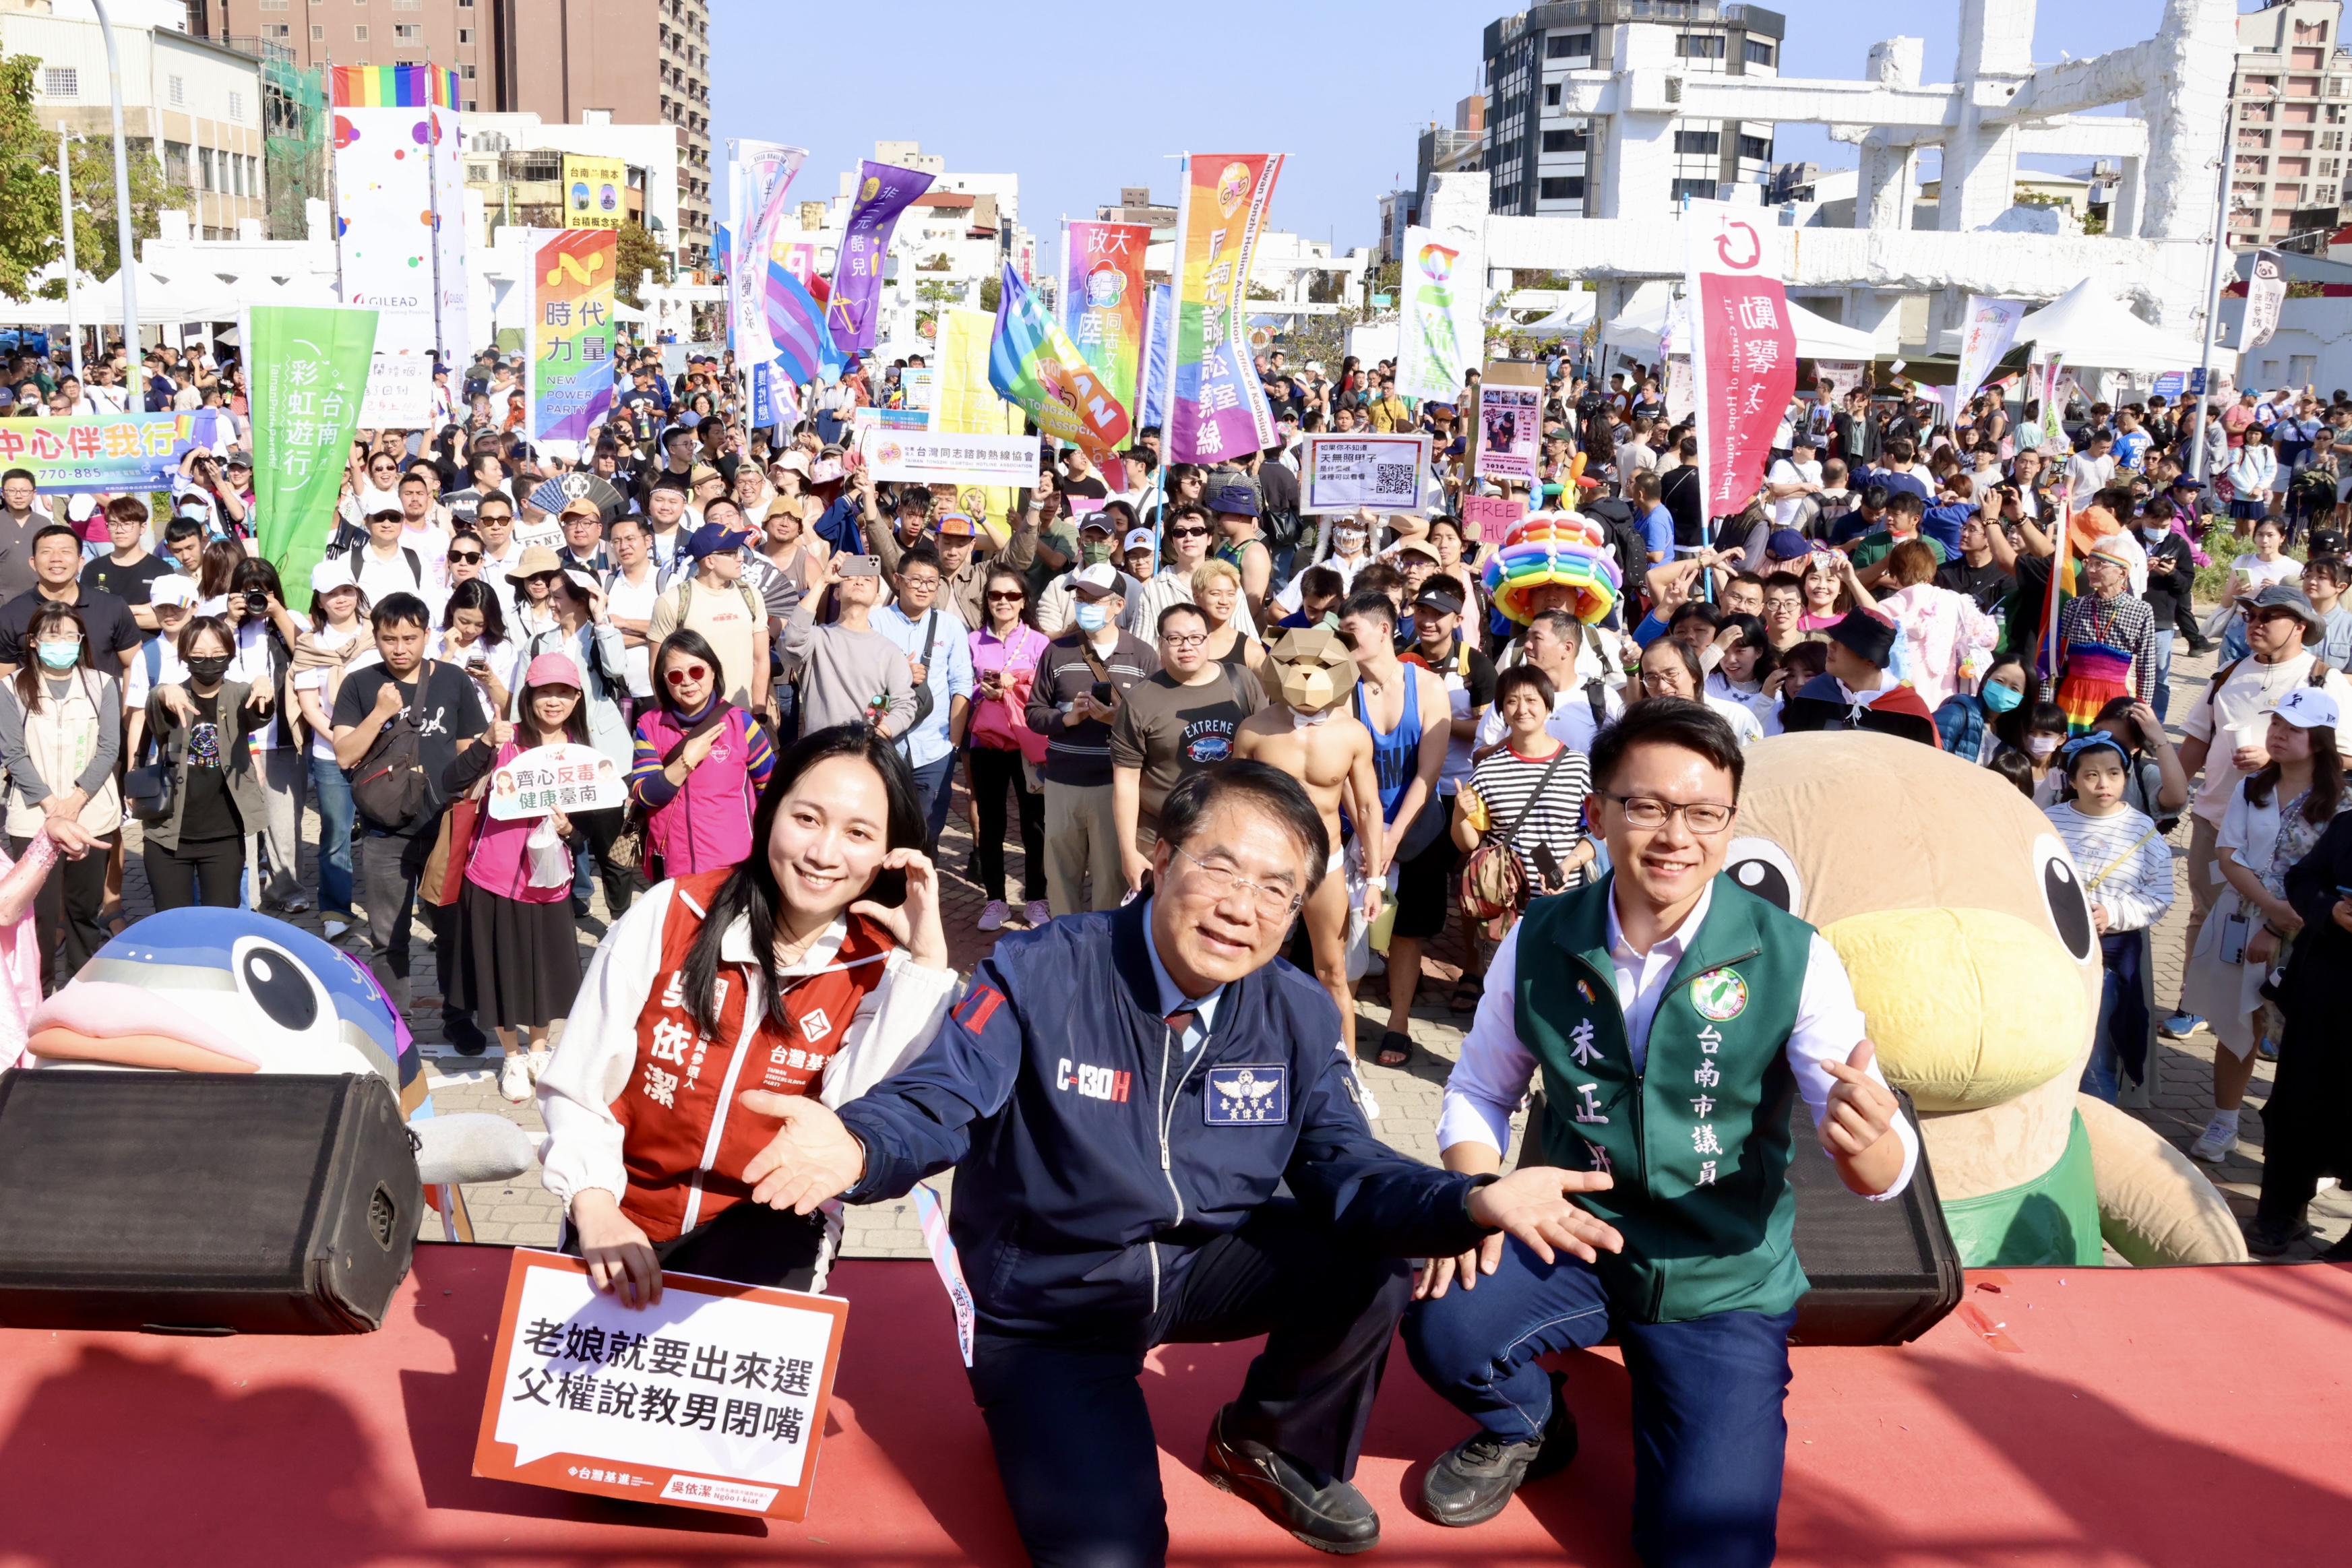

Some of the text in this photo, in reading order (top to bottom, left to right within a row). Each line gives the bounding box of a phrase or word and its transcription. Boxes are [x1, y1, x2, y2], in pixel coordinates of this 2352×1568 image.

[570, 167, 619, 180] 台南 熊本
[1258, 157, 1277, 195] Taiwan
[1247, 197, 1264, 234] Tonzhi
[850, 185, 900, 277] 非二元酷兒
[1087, 228, 1132, 255] 政大
[1237, 236, 1252, 277] Hotline
[369, 296, 418, 307] GILEAD
[545, 301, 606, 327] 時代
[1232, 280, 1243, 344] Association
[546, 336, 607, 363] 力量
[1421, 311, 1456, 394] 綠黨
[1237, 349, 1251, 377] Office
[546, 375, 577, 385] NEW
[546, 389, 592, 400] POWER
[283, 358, 320, 476] 彩虹遊行
[317, 391, 344, 446] 台南
[546, 404, 588, 414] PARTY
[1251, 391, 1269, 445] Kaohsiung
[0, 420, 177, 462] 中心伴我行
[916, 445, 1034, 462] 台灣同志諮詢熱線協會
[1320, 453, 1377, 464] 天無照甲子
[1470, 501, 1516, 518] FREE
[1183, 719, 1234, 739] EXTREME
[516, 763, 595, 788] 齊心反毒
[519, 784, 598, 810] 健康臺南
[762, 1079, 782, 1088] PARTY
[764, 1073, 807, 1086] STATEBUILDING
[766, 1067, 788, 1076] TAIWAN
[1056, 1058, 1132, 1103] C-130H
[1220, 1097, 1274, 1110] 臺南市長
[1229, 1108, 1266, 1121] 黃偉哲
[1689, 1024, 1723, 1187] 台南市議員
[523, 1317, 814, 1398] 老娘就要出來選
[512, 1365, 804, 1445] 父權說教男閉嘴
[578, 1466, 631, 1486] 台灣基進
[671, 1480, 712, 1498] 吳依潔
